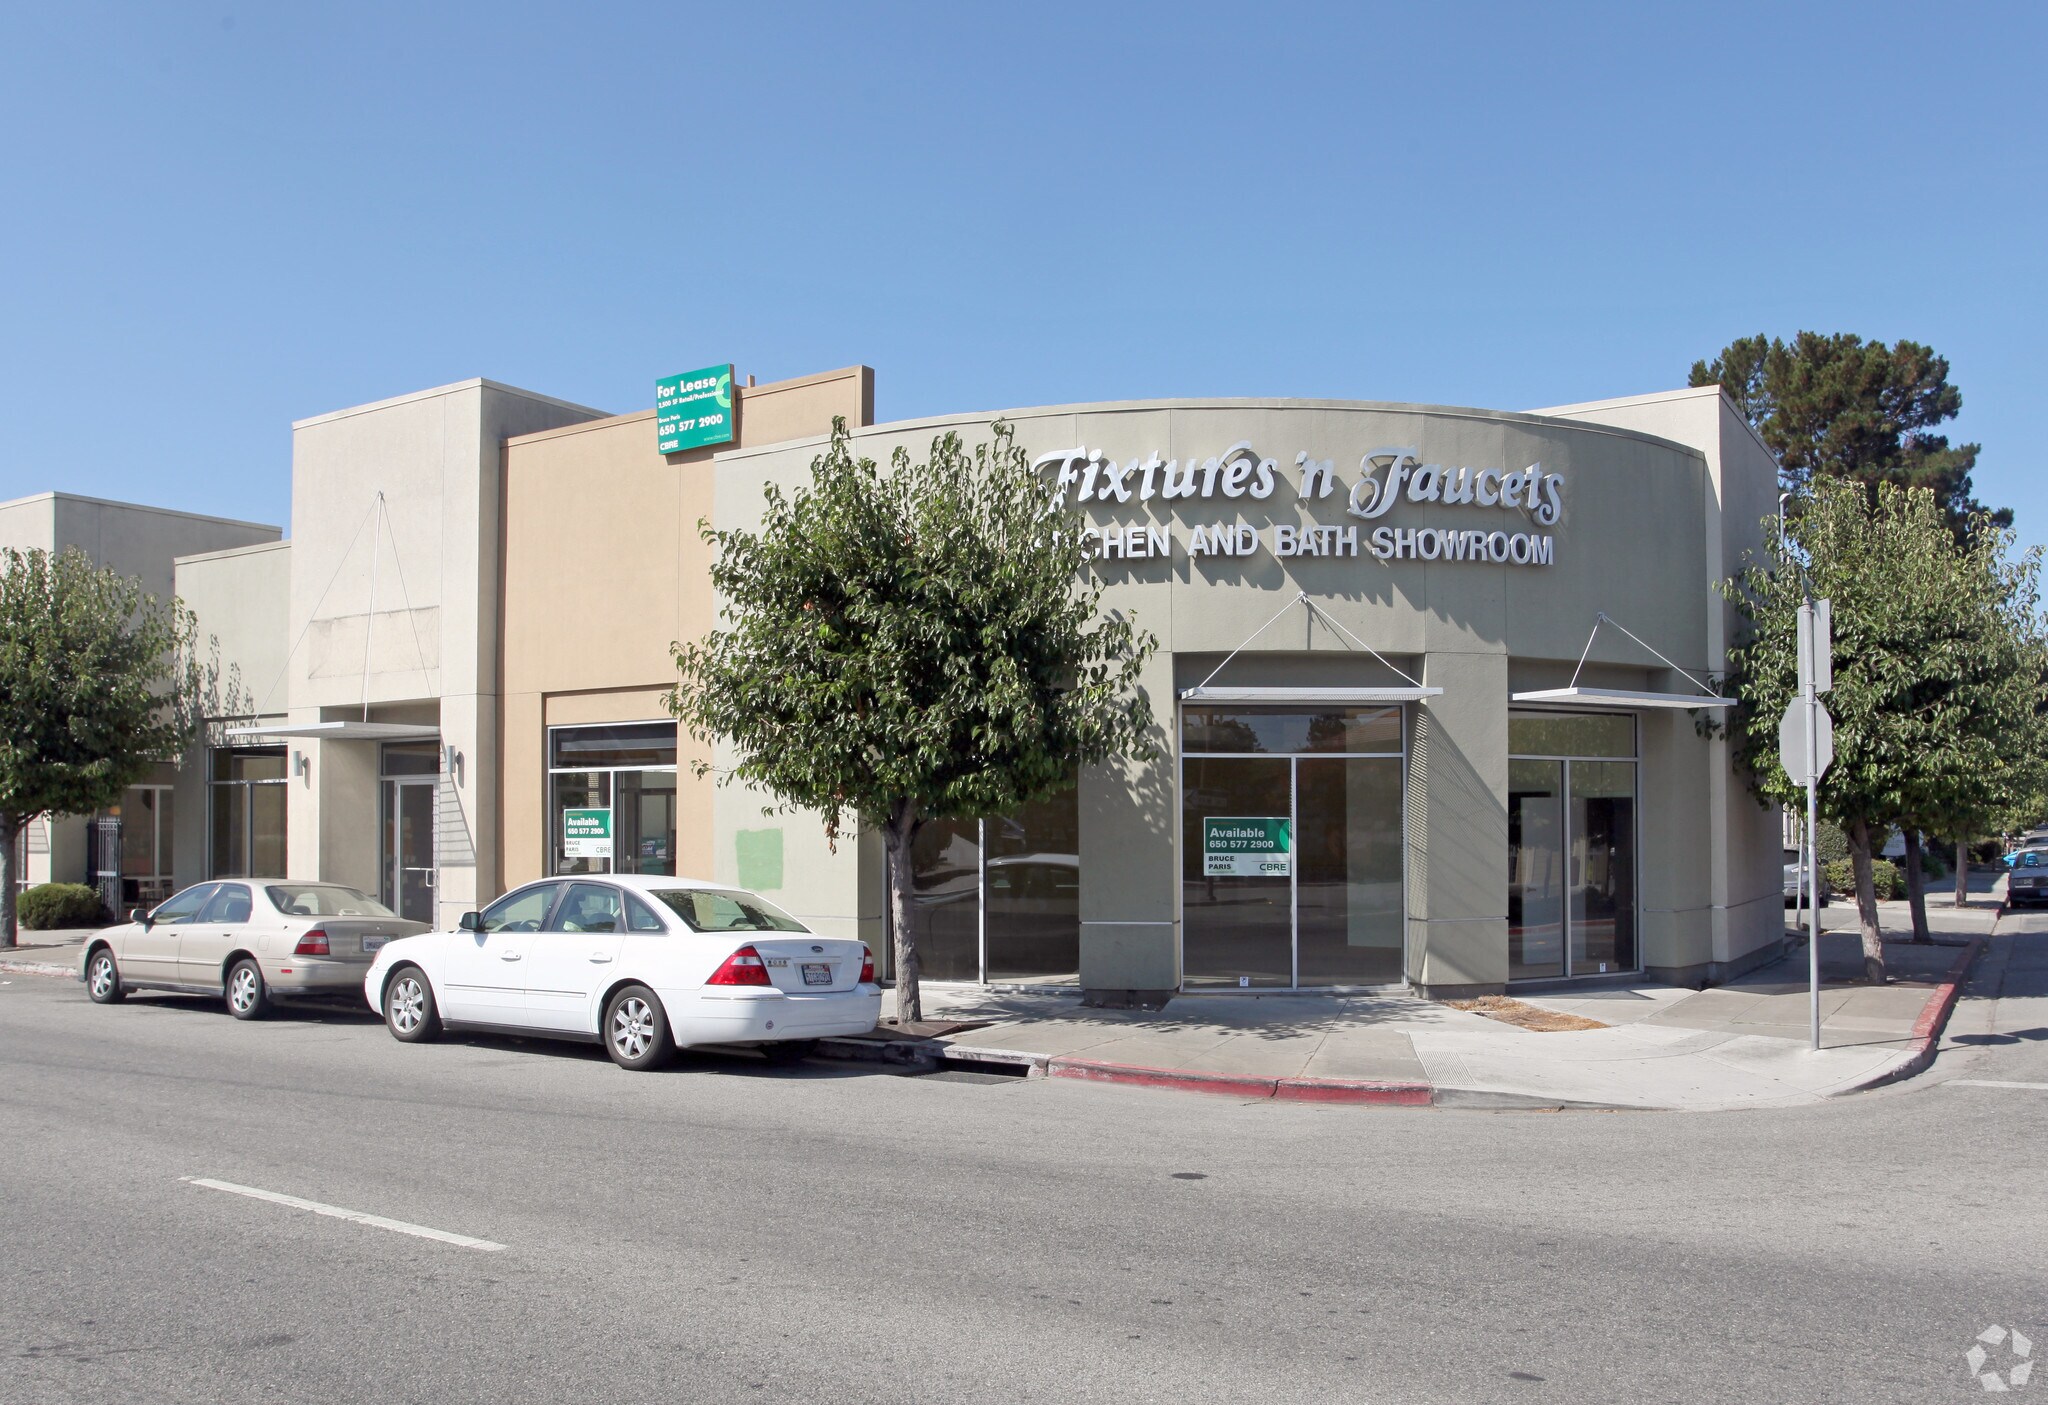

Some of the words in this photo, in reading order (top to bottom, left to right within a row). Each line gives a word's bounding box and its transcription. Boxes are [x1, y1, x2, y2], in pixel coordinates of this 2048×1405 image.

[657, 385, 676, 399] For
[680, 377, 717, 393] Lease
[659, 424, 675, 436] 650
[679, 419, 695, 431] 577
[699, 414, 723, 428] 2900
[660, 440, 678, 450] CBRE
[1030, 440, 1278, 522] Fixtures
[1347, 446, 1564, 527] Faucets
[1187, 524, 1259, 557] AND
[1274, 525, 1358, 557] BATH
[1372, 527, 1555, 566] SHOWROOM
[568, 818, 599, 826] Available
[1209, 828, 1265, 838] Available
[1209, 840, 1227, 848] 650
[1230, 840, 1247, 848] 577
[1250, 840, 1274, 848] 2900
[1259, 863, 1287, 871] CBRE
